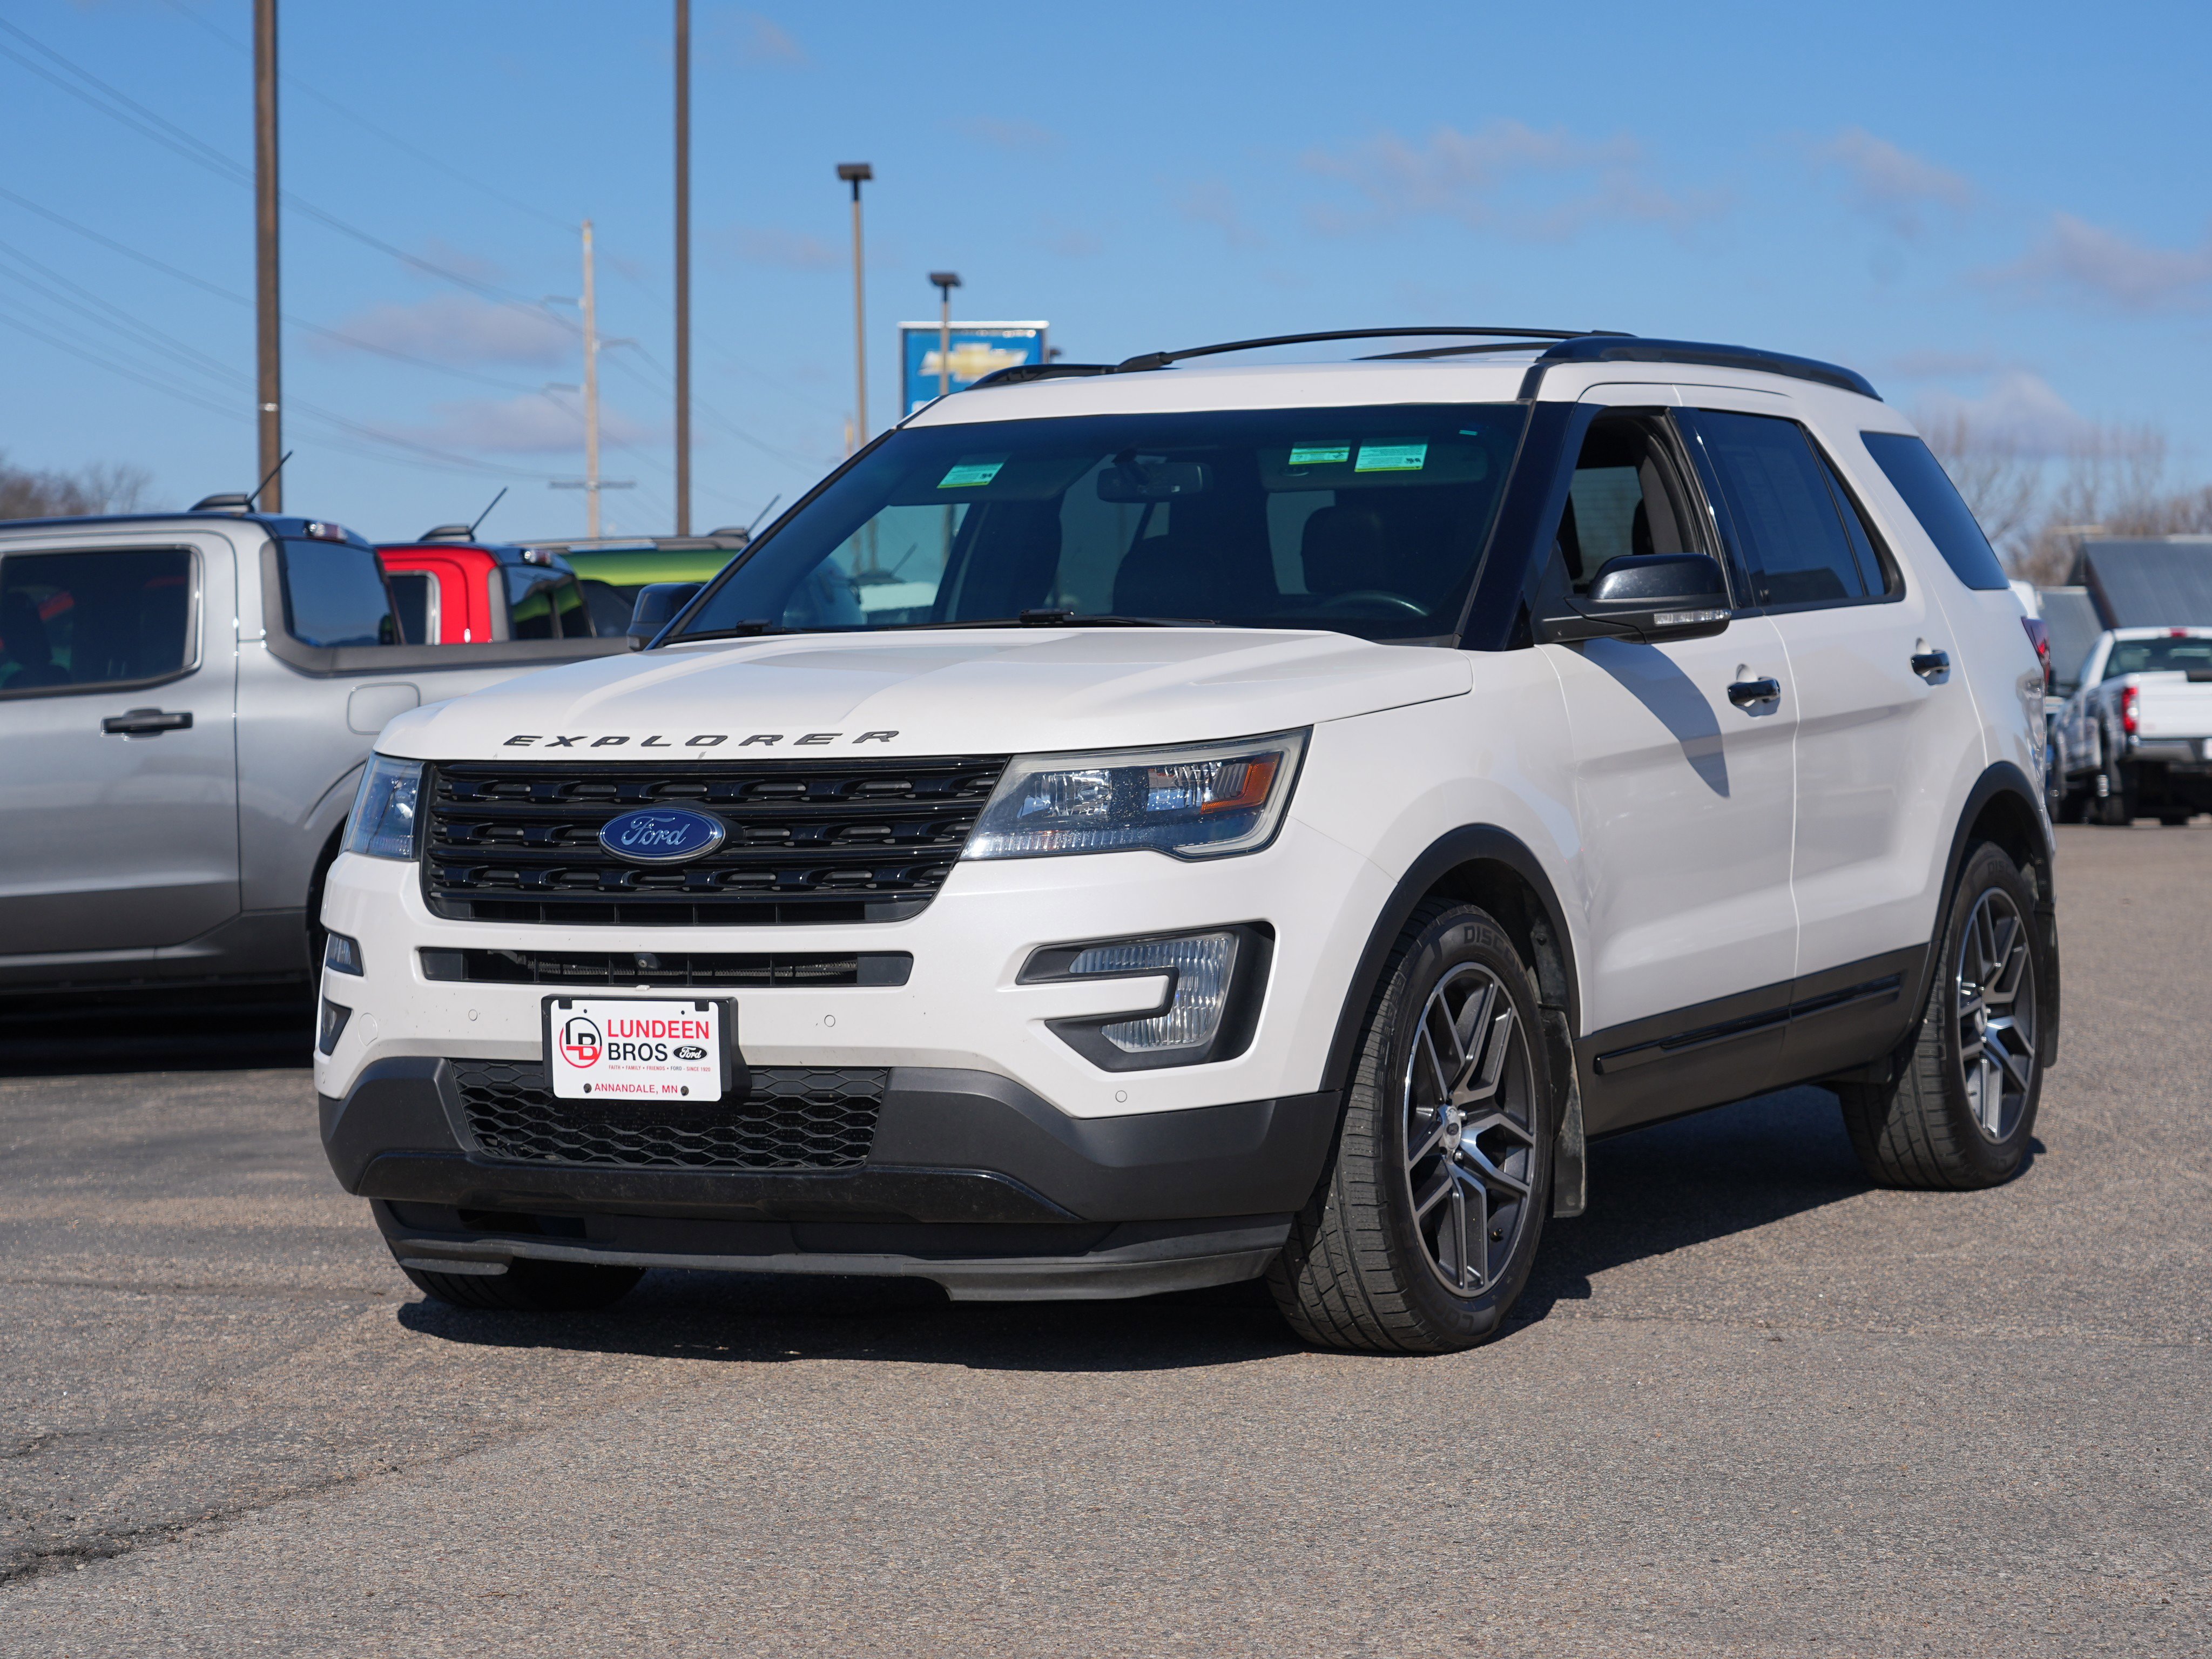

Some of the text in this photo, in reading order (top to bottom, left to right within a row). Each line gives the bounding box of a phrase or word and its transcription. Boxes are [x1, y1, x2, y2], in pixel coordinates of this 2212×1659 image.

[502, 731, 899, 747] EXPLORER
[621, 815, 687, 848] Ford
[608, 1019, 710, 1040] LUNDEEN
[608, 1042, 668, 1062] BROS
[679, 1046, 703, 1059] Ford
[594, 1083, 678, 1095] ANNANDALE, MN
